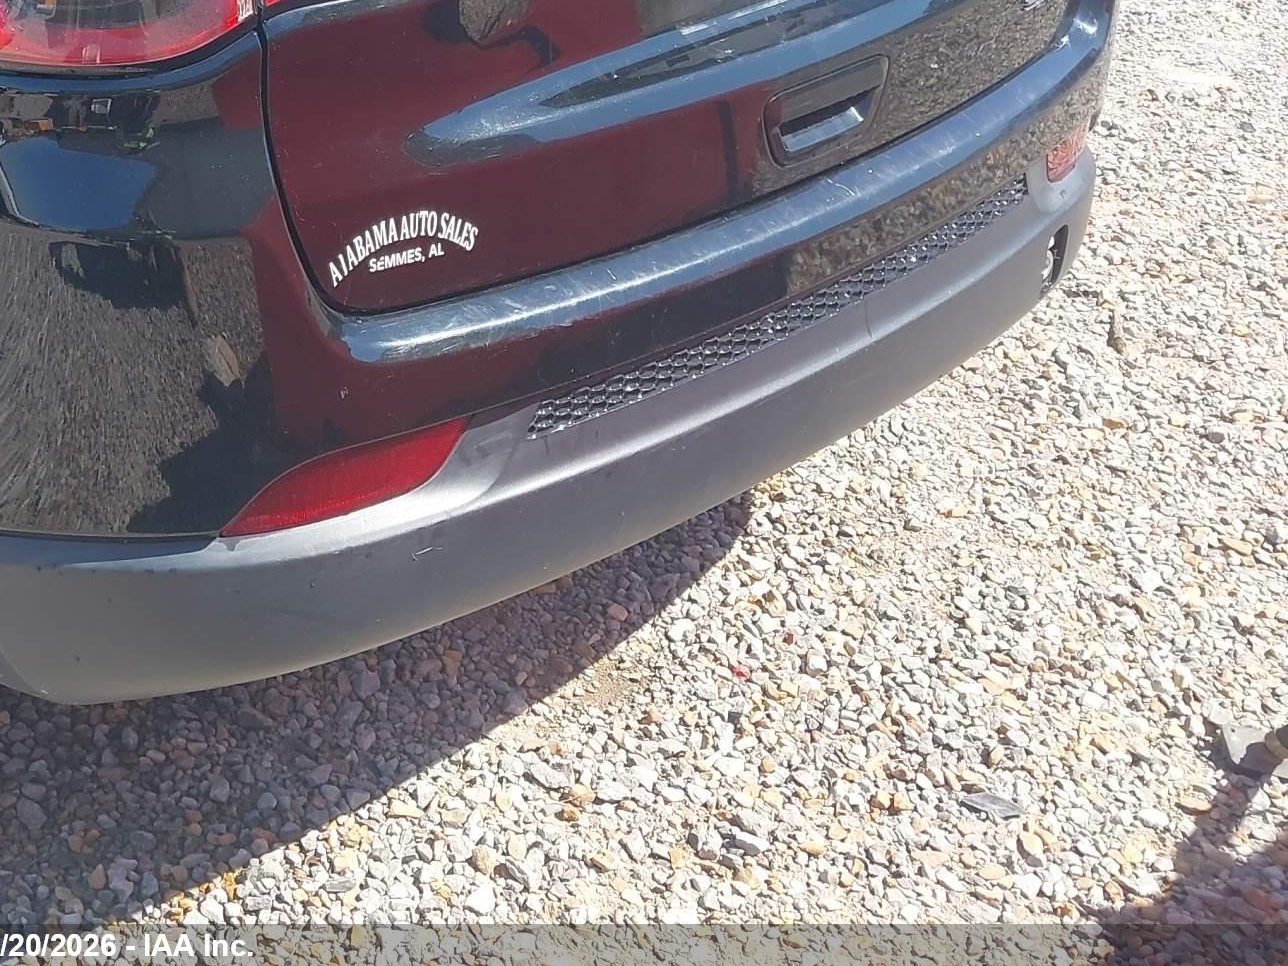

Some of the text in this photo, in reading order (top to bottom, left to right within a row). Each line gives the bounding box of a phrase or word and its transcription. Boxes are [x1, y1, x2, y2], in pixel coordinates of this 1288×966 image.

[399, 210, 438, 241] AUTO
[438, 212, 479, 252] SALES
[368, 242, 445, 273] SEMMES, AL
